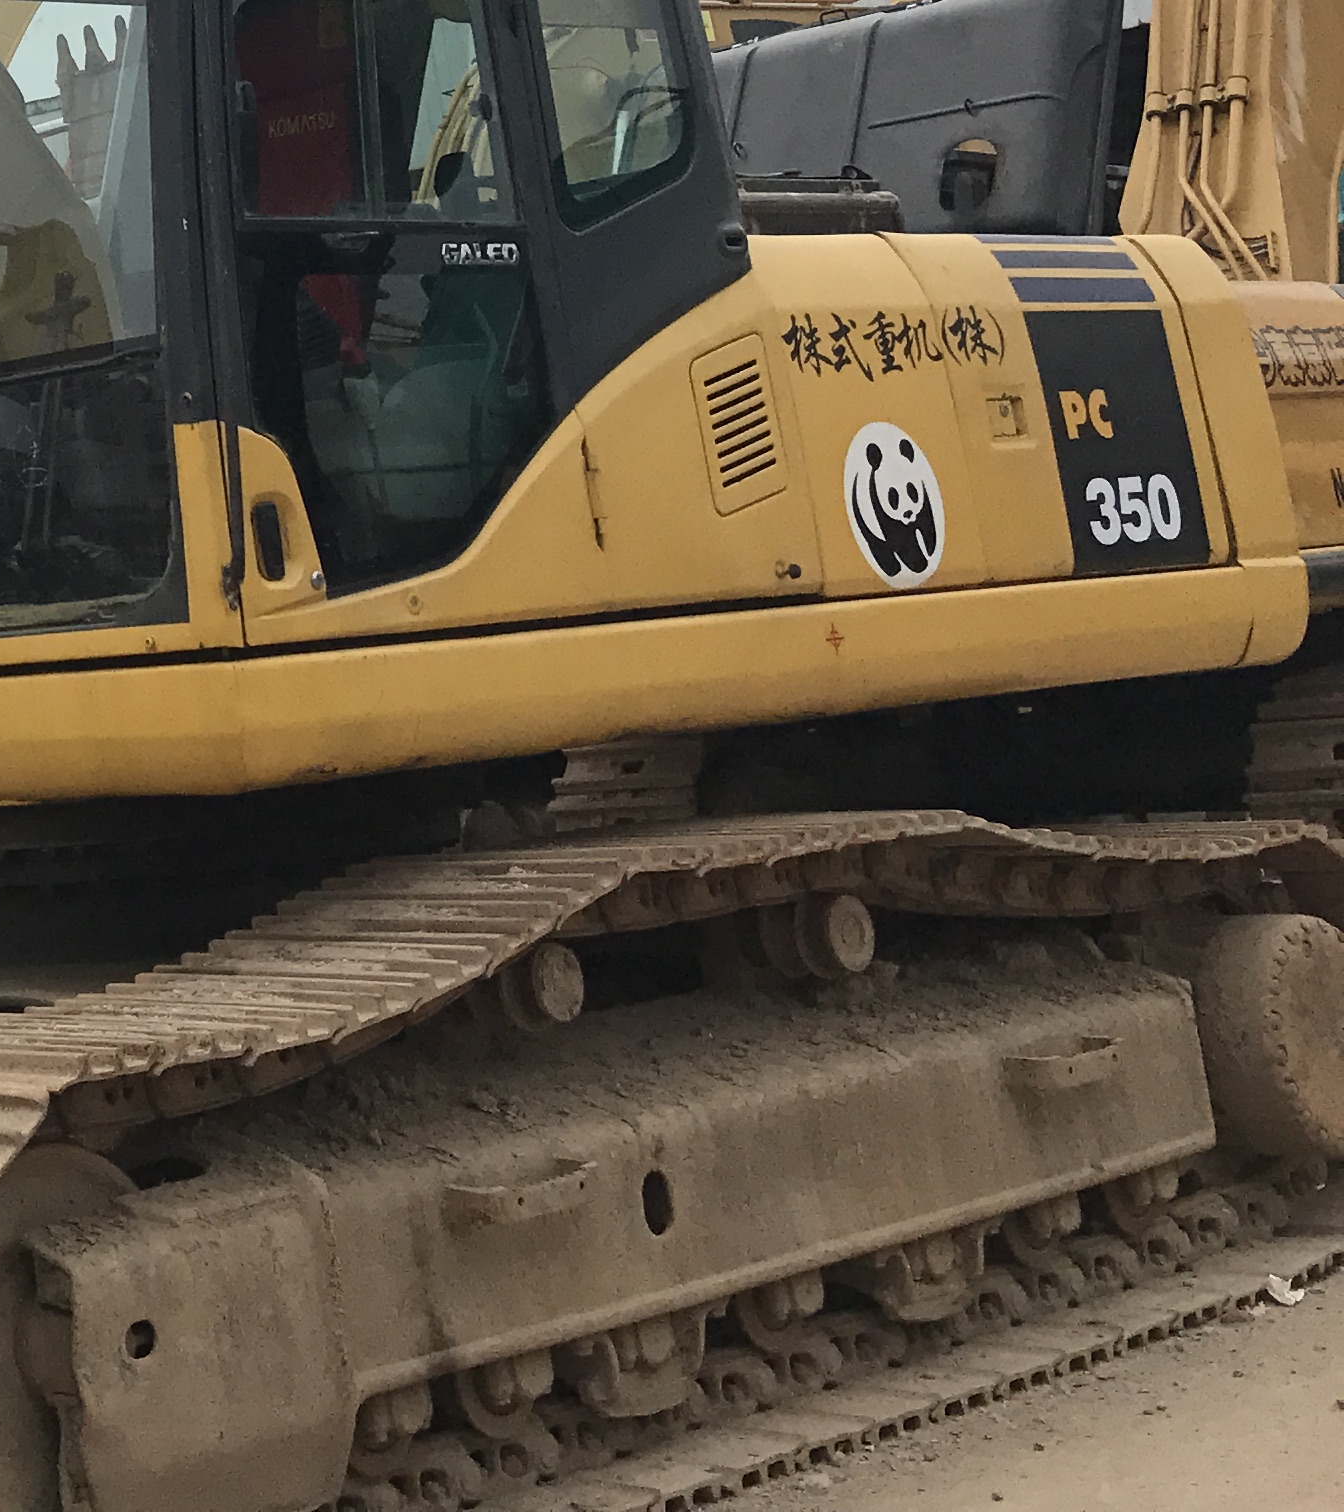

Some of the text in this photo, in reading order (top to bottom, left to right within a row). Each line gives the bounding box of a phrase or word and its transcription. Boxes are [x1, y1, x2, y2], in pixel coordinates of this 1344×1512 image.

[268, 110, 336, 139] KOMATSU
[1058, 388, 1114, 440] PC
[1085, 473, 1182, 546] 350
